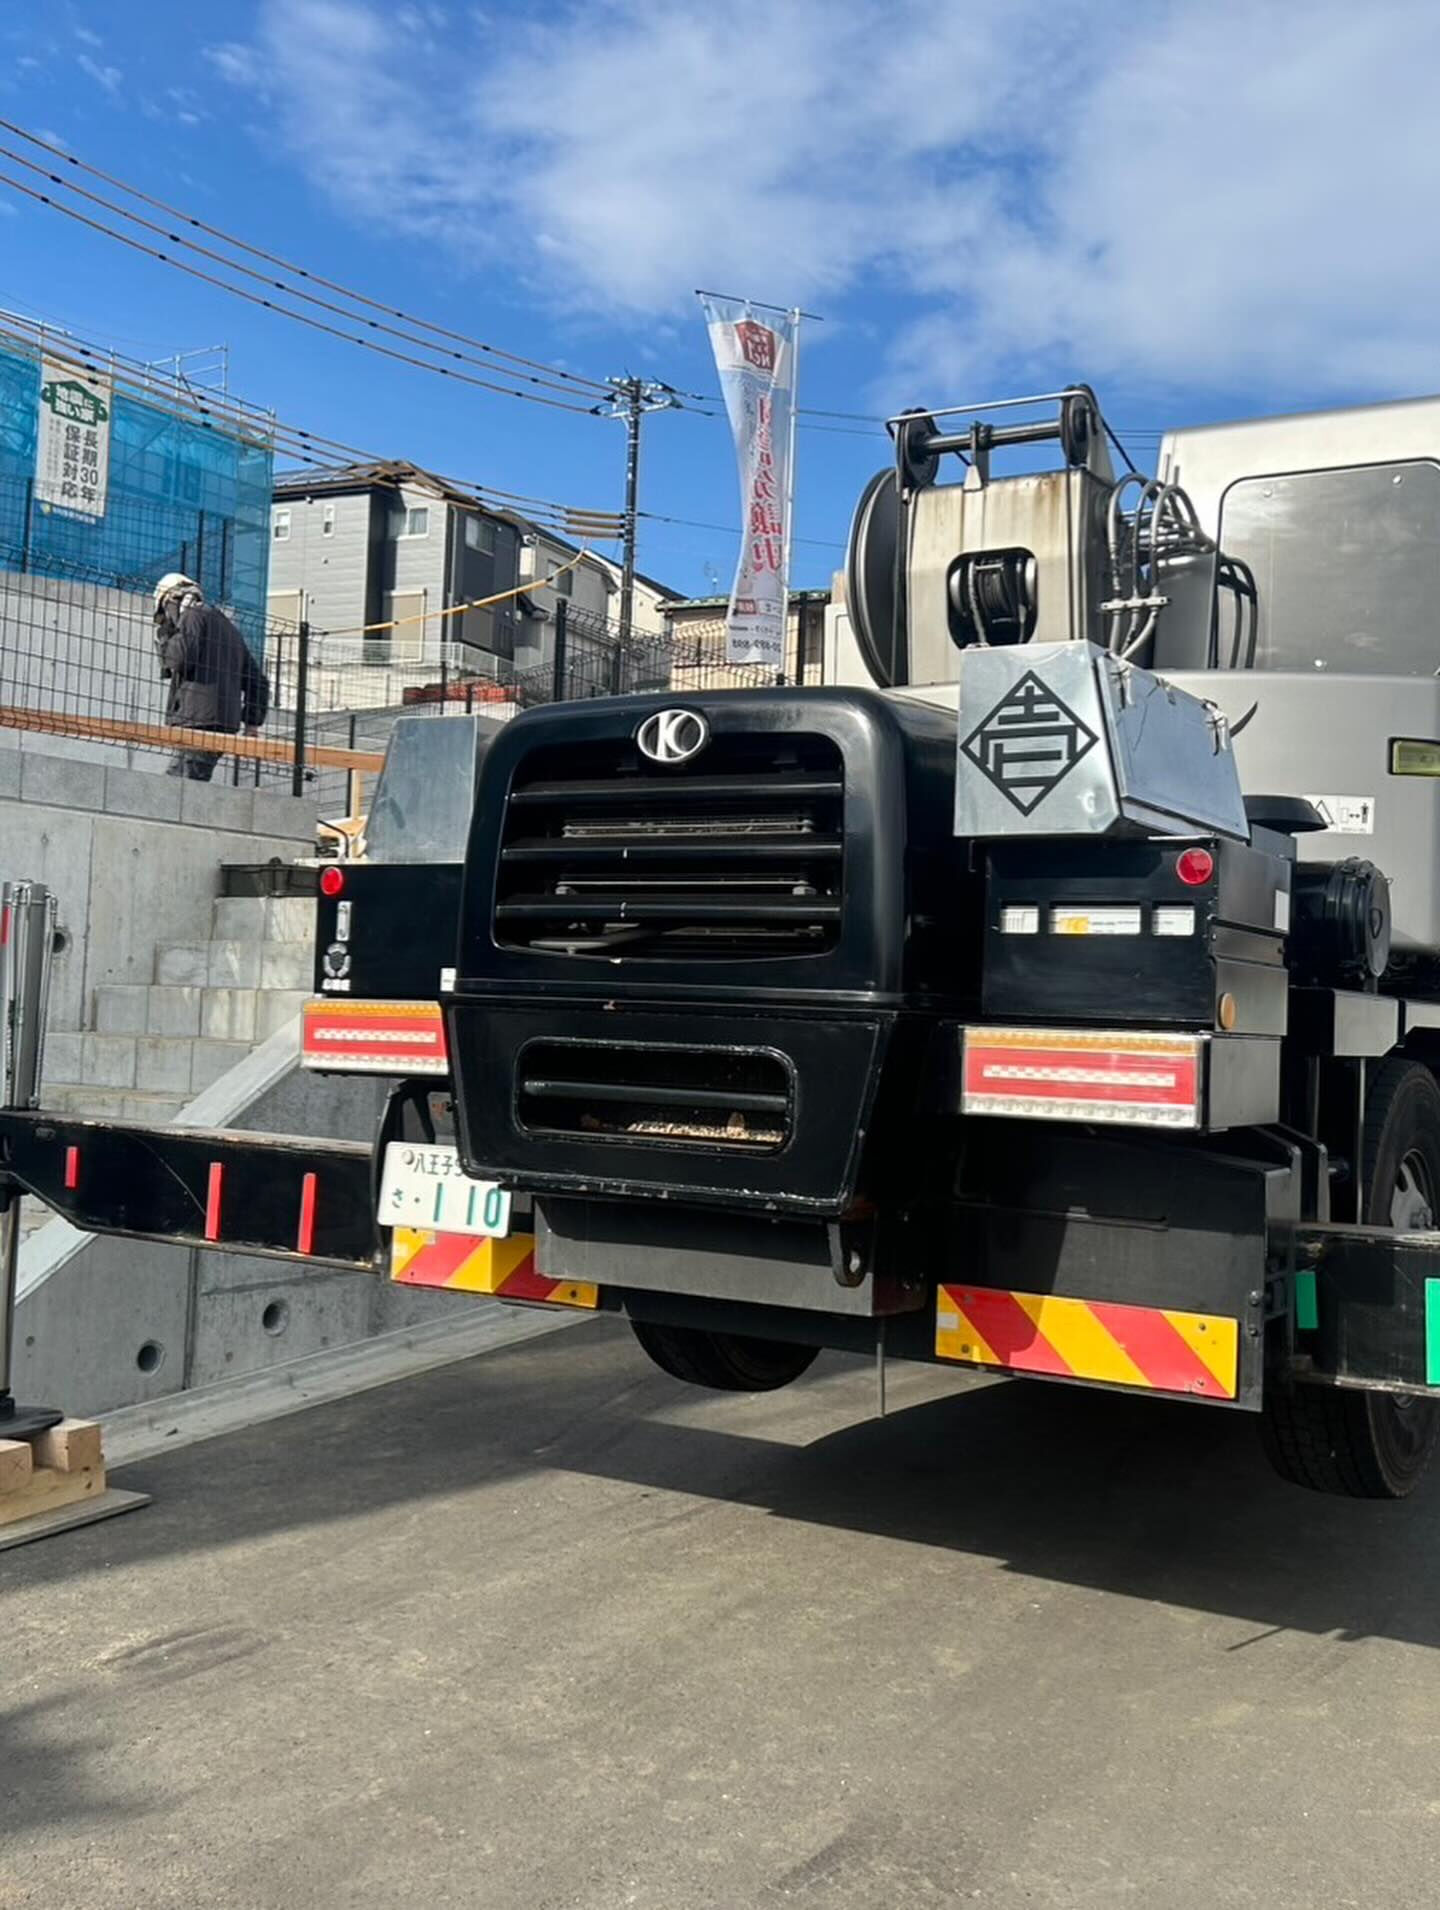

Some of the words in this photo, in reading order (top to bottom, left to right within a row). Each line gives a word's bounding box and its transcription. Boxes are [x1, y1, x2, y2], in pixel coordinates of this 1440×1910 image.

[61, 424, 81, 498] 保証対応
[80, 430, 98, 503] 長期30年
[392, 1188, 403, 1208] さ
